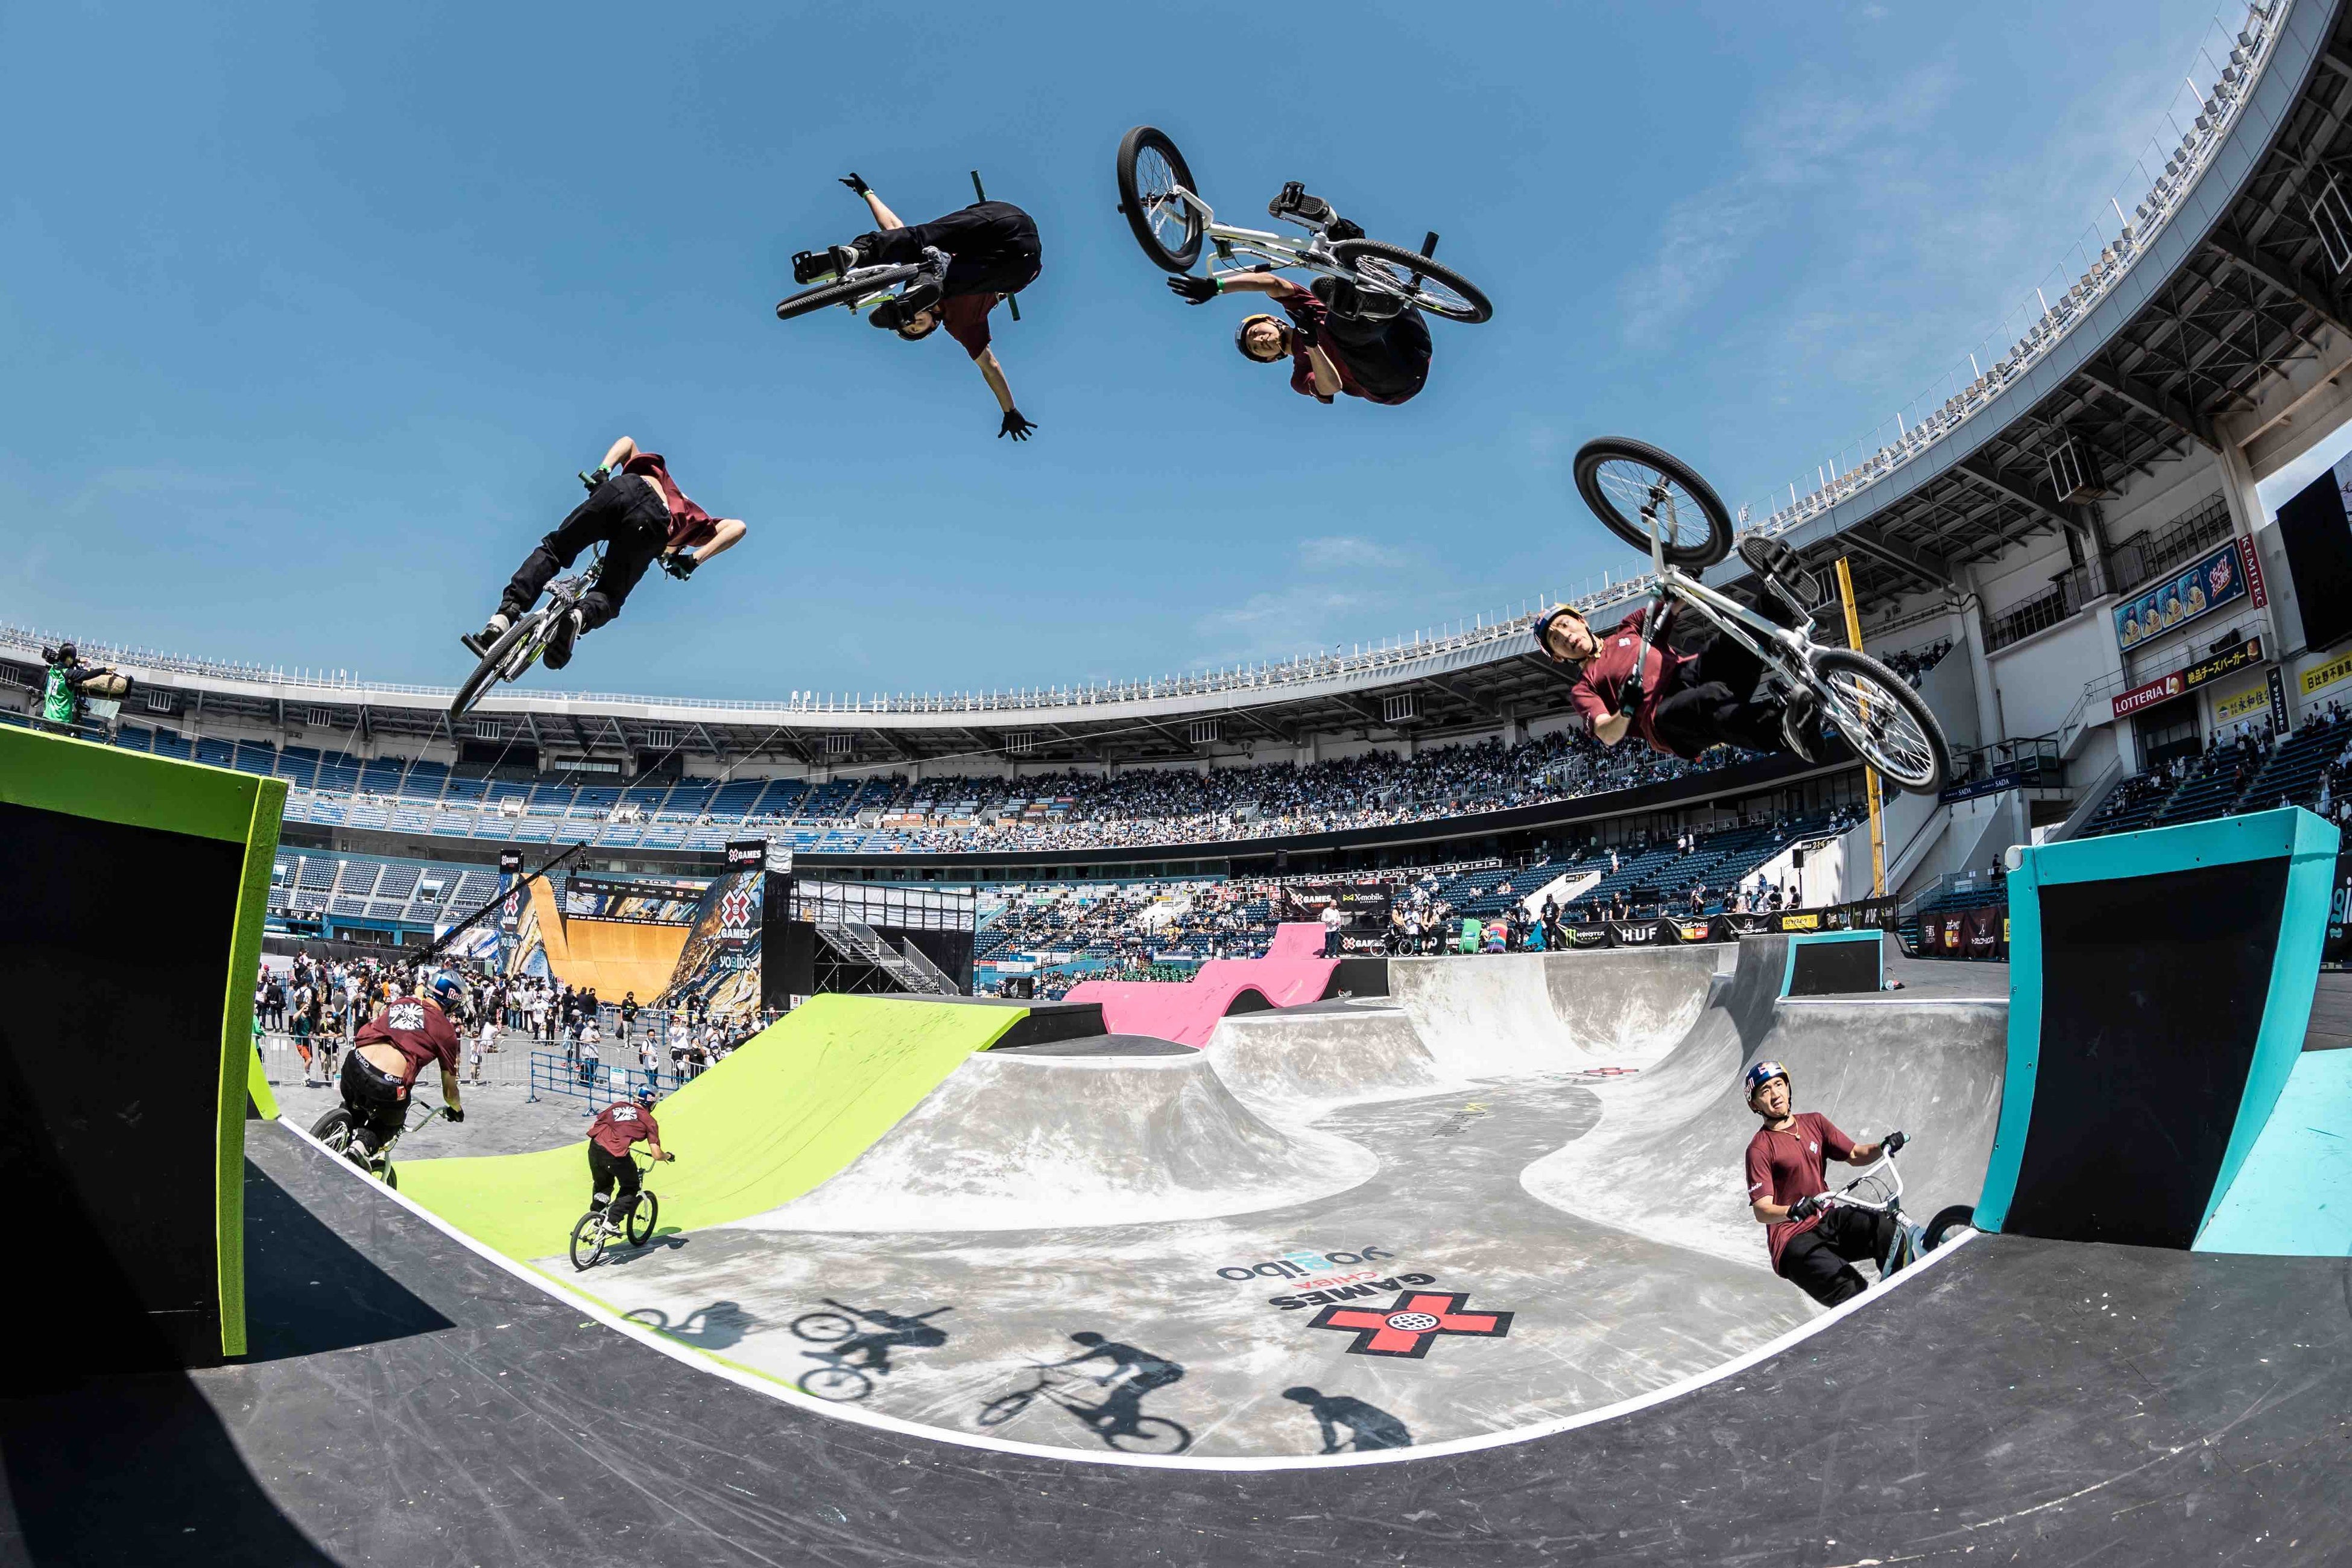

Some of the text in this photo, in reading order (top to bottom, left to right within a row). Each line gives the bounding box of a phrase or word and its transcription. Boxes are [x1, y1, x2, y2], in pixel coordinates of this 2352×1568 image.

[2242, 536, 2265, 607] KEMITEC
[2187, 651, 2246, 684] 絶品チーズバーガー
[2116, 686, 2164, 713] LOTTERIA
[1995, 778, 2009, 787] SADA
[1958, 788, 1971, 796] SADA
[738, 850, 761, 859] GAMES
[1303, 895, 1332, 903] GAMES
[502, 916, 518, 925] GAMES
[721, 928, 750, 939] GAMES
[1622, 927, 1657, 941] HUF
[719, 953, 751, 972] yogibo
[1216, 1245, 1395, 1281] yogibo
[1292, 1271, 1378, 1290] CHIBA
[1268, 1273, 1437, 1310] GAMES
